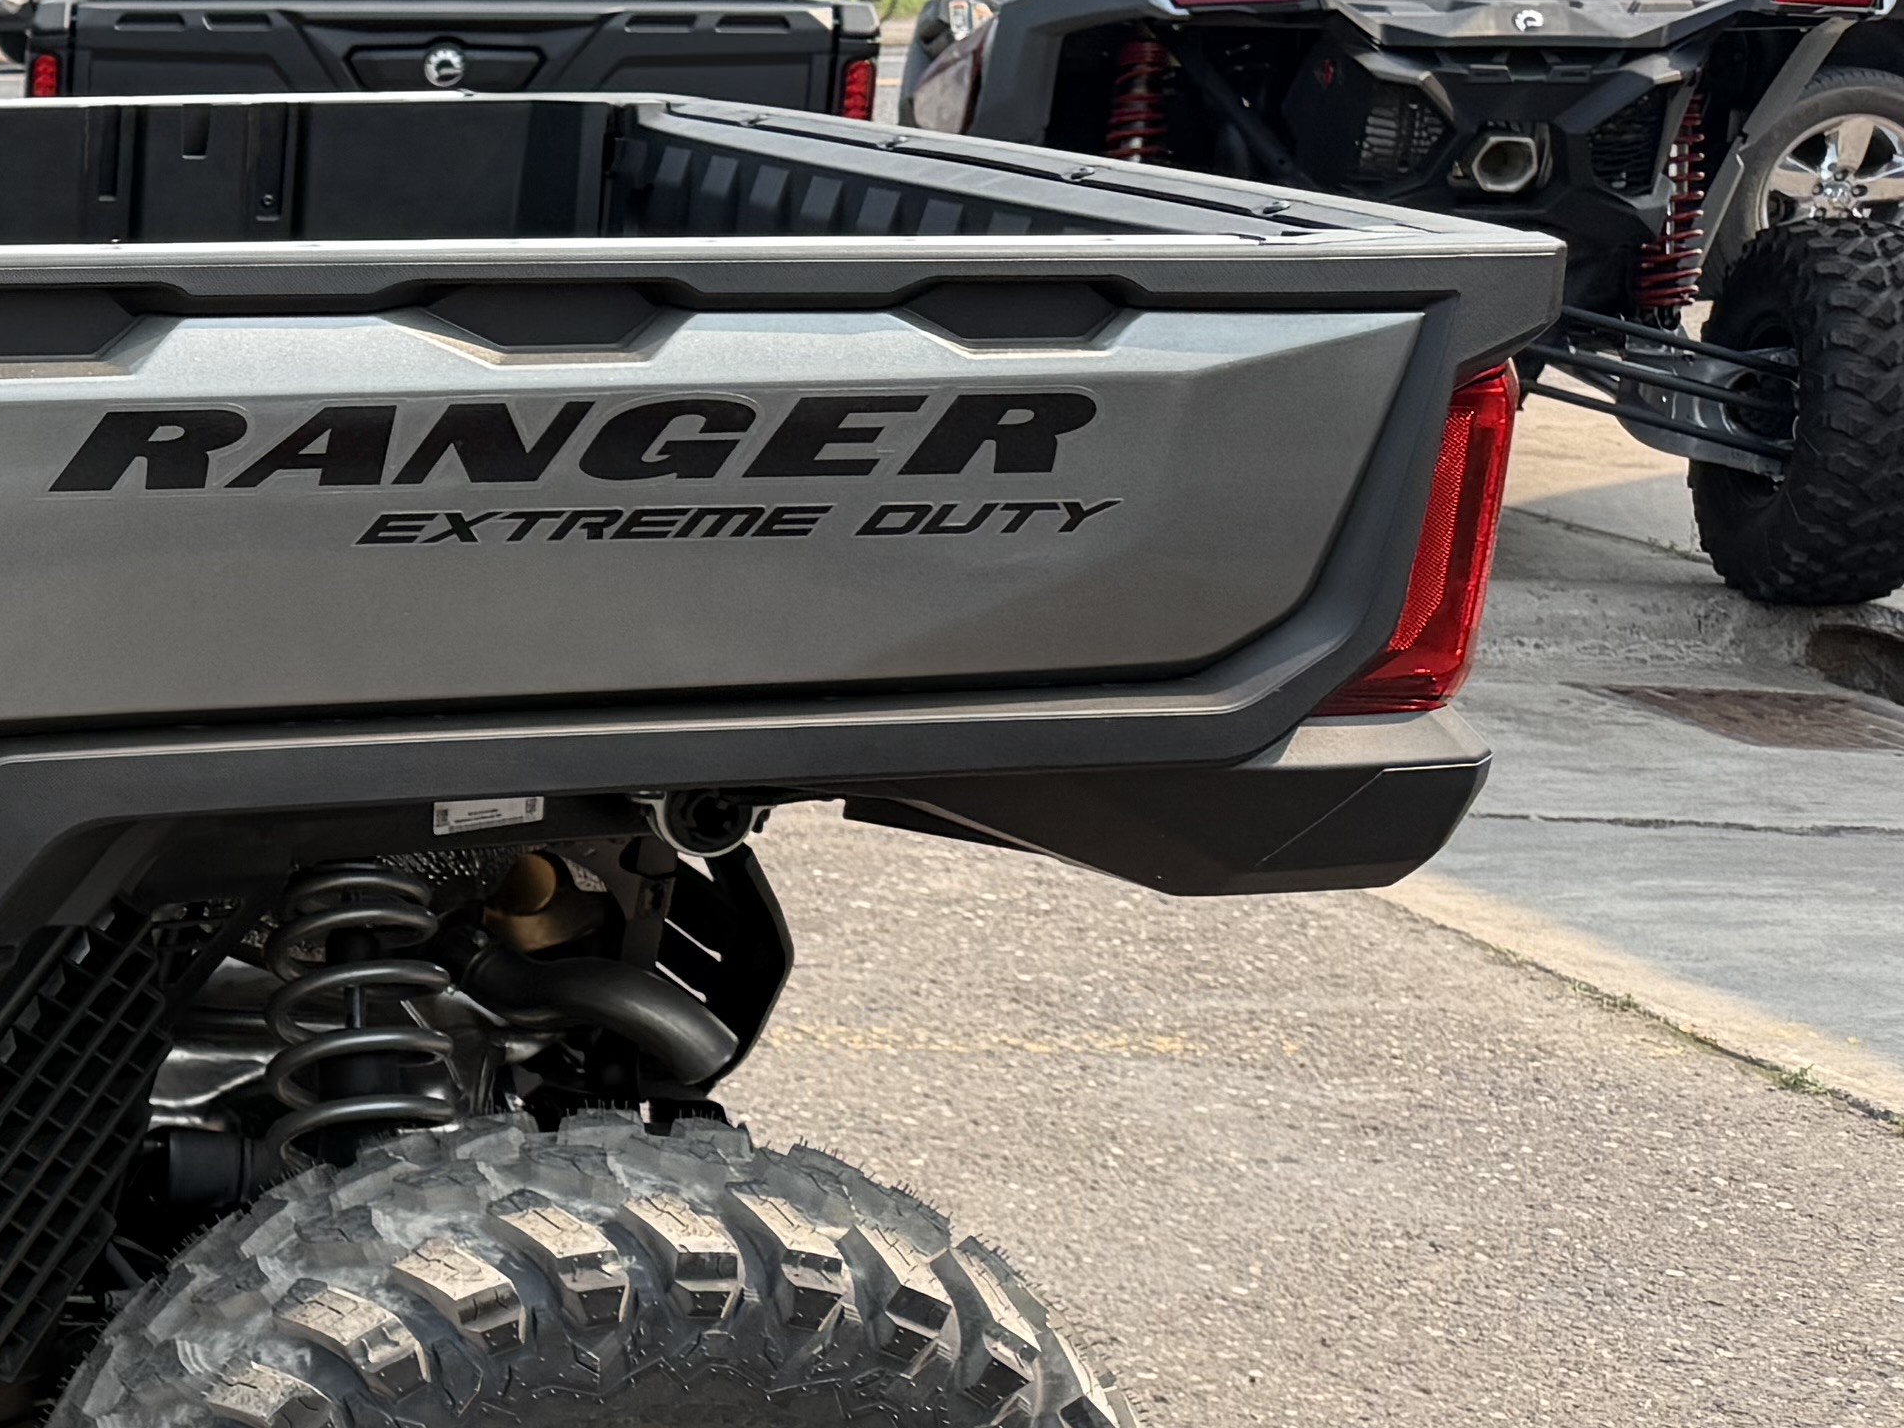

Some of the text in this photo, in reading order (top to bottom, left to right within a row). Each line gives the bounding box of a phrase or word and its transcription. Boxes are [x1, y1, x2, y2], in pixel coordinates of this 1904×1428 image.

[48, 394, 1098, 493] RANGER
[353, 500, 1120, 545] EXTREME DUTY
